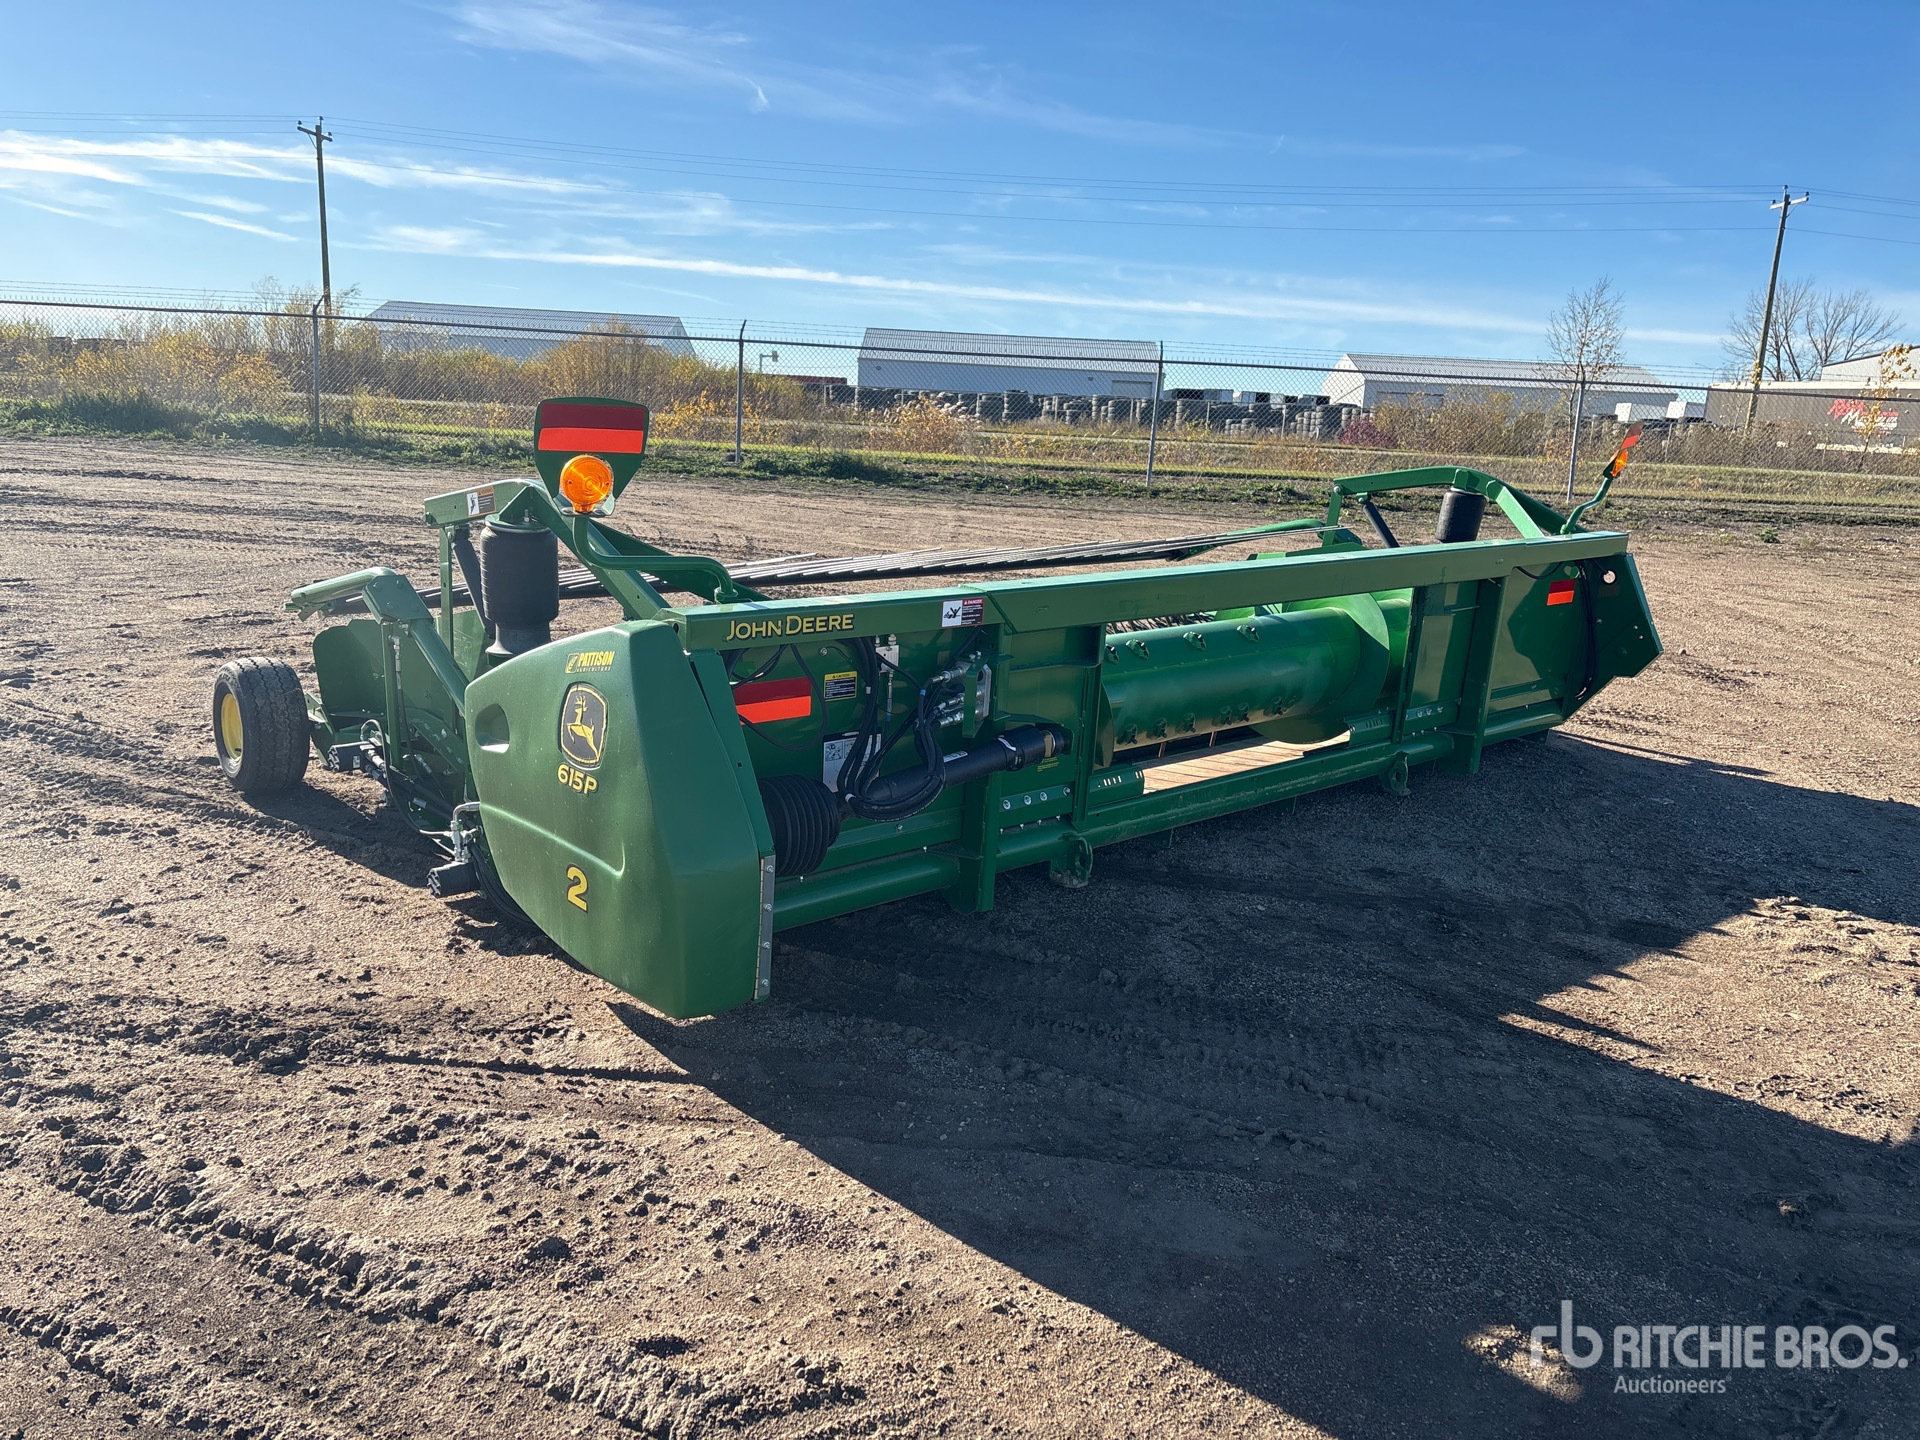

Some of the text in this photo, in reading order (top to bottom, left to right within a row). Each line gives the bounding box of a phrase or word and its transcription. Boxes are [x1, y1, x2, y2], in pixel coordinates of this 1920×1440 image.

[726, 614, 855, 641] JOHN DEERE
[578, 650, 616, 667] PATTISON
[557, 763, 599, 796] 615P
[566, 864, 589, 913] 2
